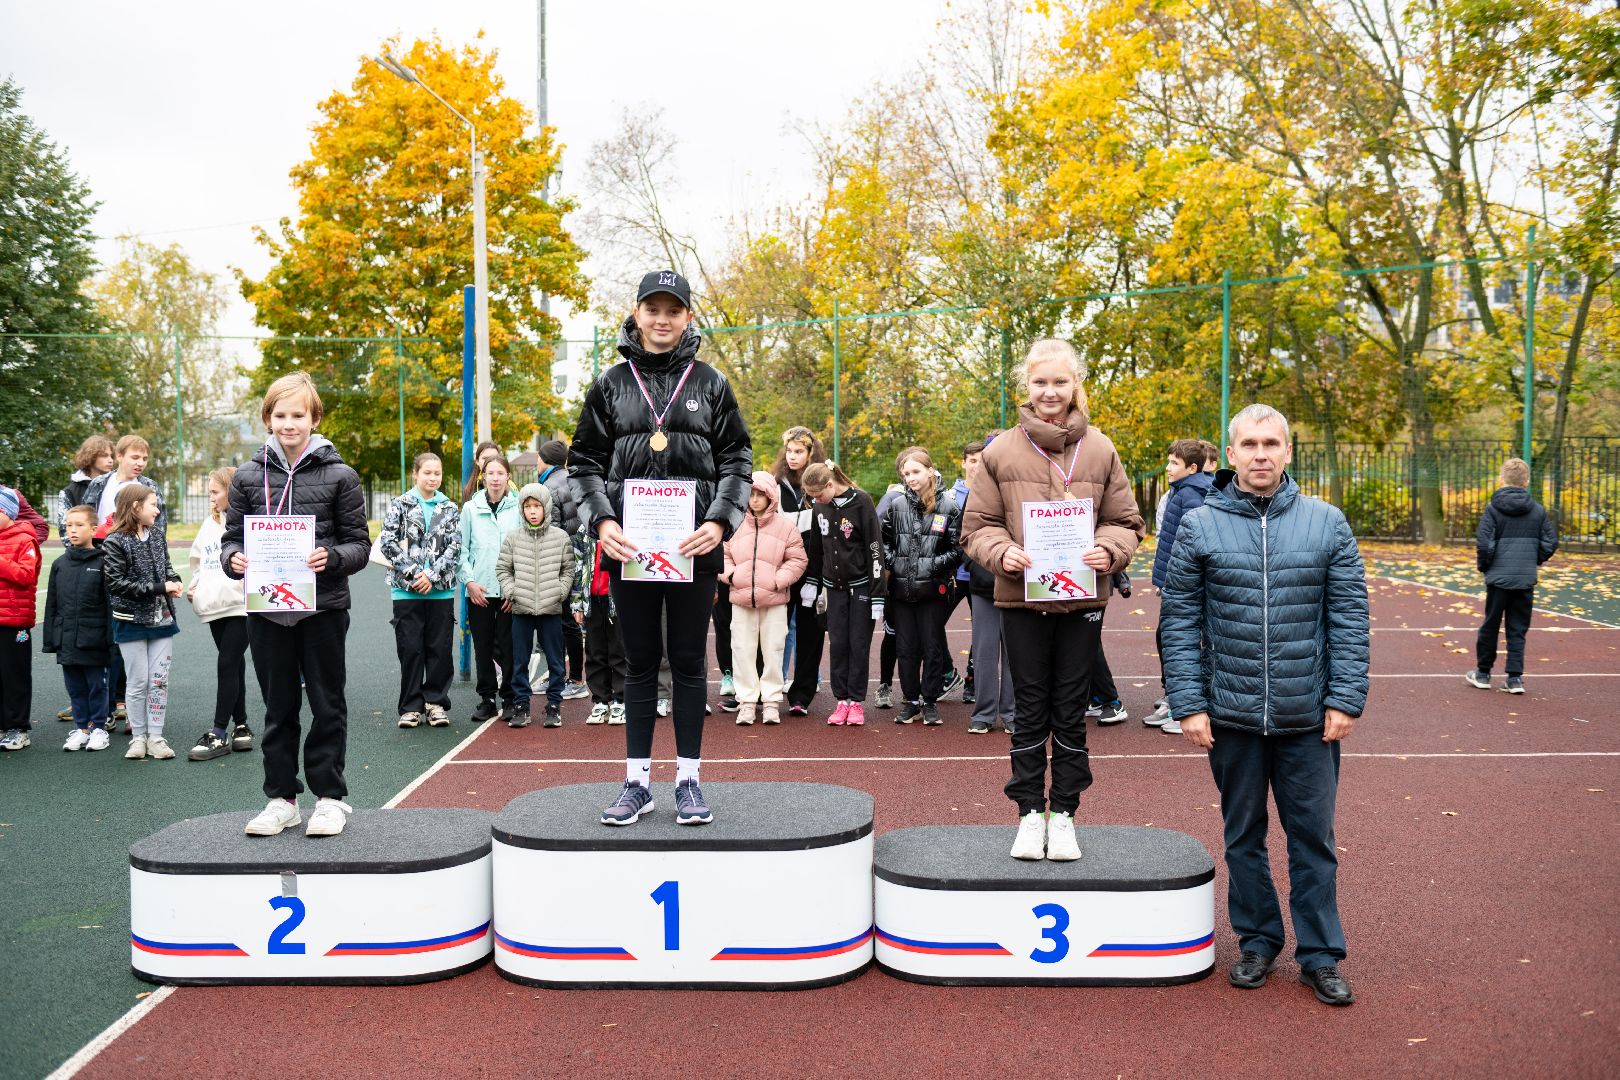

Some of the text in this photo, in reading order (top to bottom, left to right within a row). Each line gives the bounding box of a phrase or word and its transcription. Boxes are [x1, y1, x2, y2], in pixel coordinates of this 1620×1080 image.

[631, 486, 687, 497] ГРАМОТА
[251, 521, 307, 531] ГРАМОТА
[1030, 506, 1086, 518] ГРАМОТА
[267, 895, 306, 955] 2
[650, 881, 679, 950] 1
[1029, 903, 1070, 963] 3
